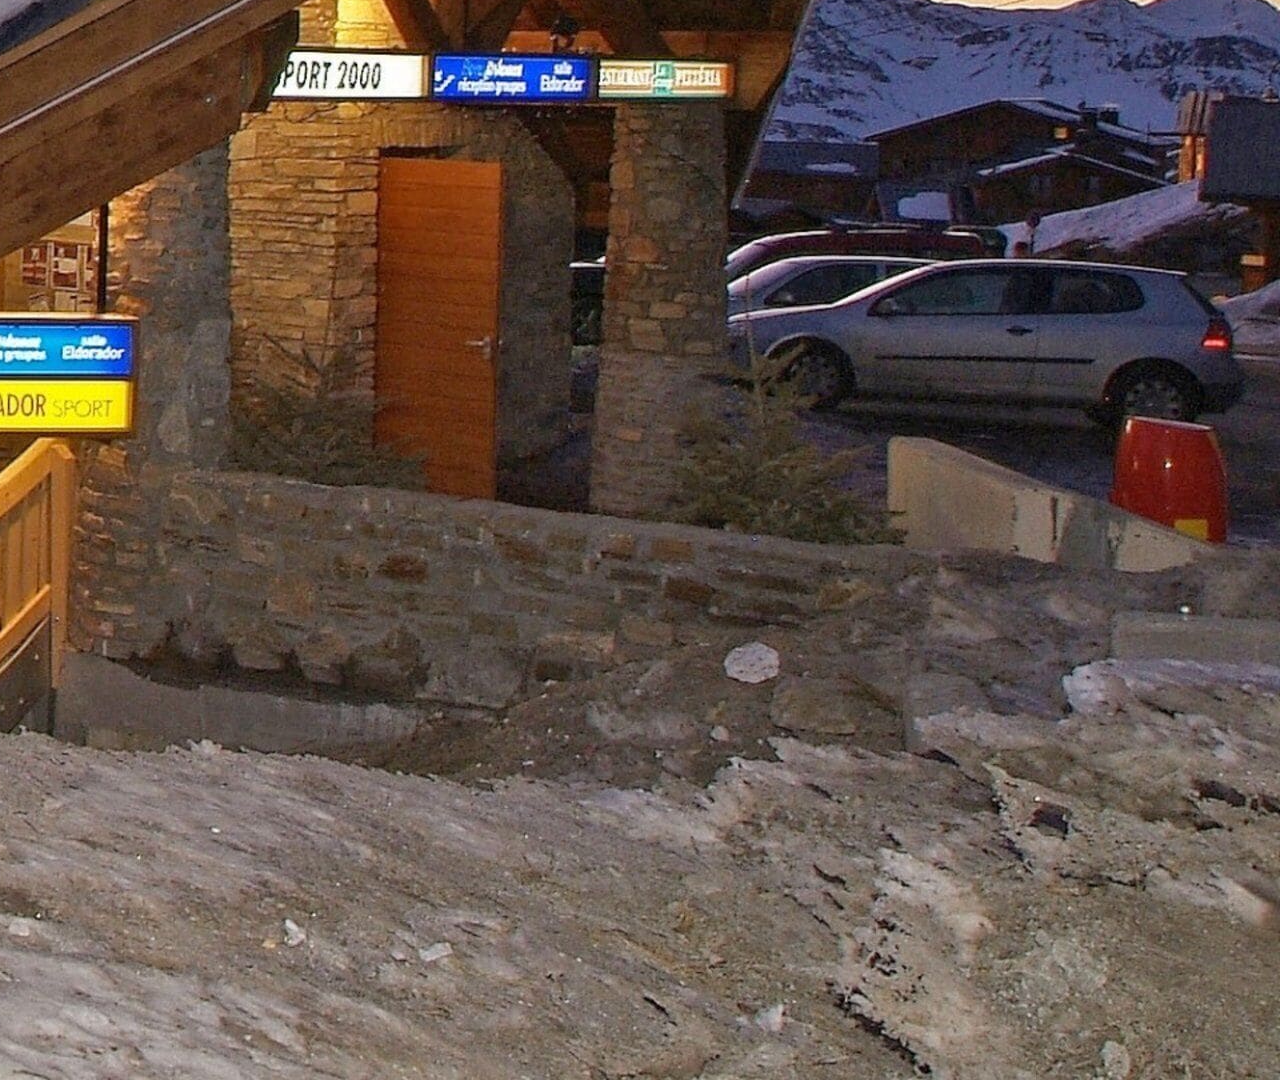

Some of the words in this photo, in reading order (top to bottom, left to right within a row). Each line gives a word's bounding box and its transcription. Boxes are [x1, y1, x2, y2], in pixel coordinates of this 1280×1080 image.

[337, 60, 381, 89] 2000
[62, 345, 125, 360] Eldorador
[52, 399, 113, 418] SPORT
